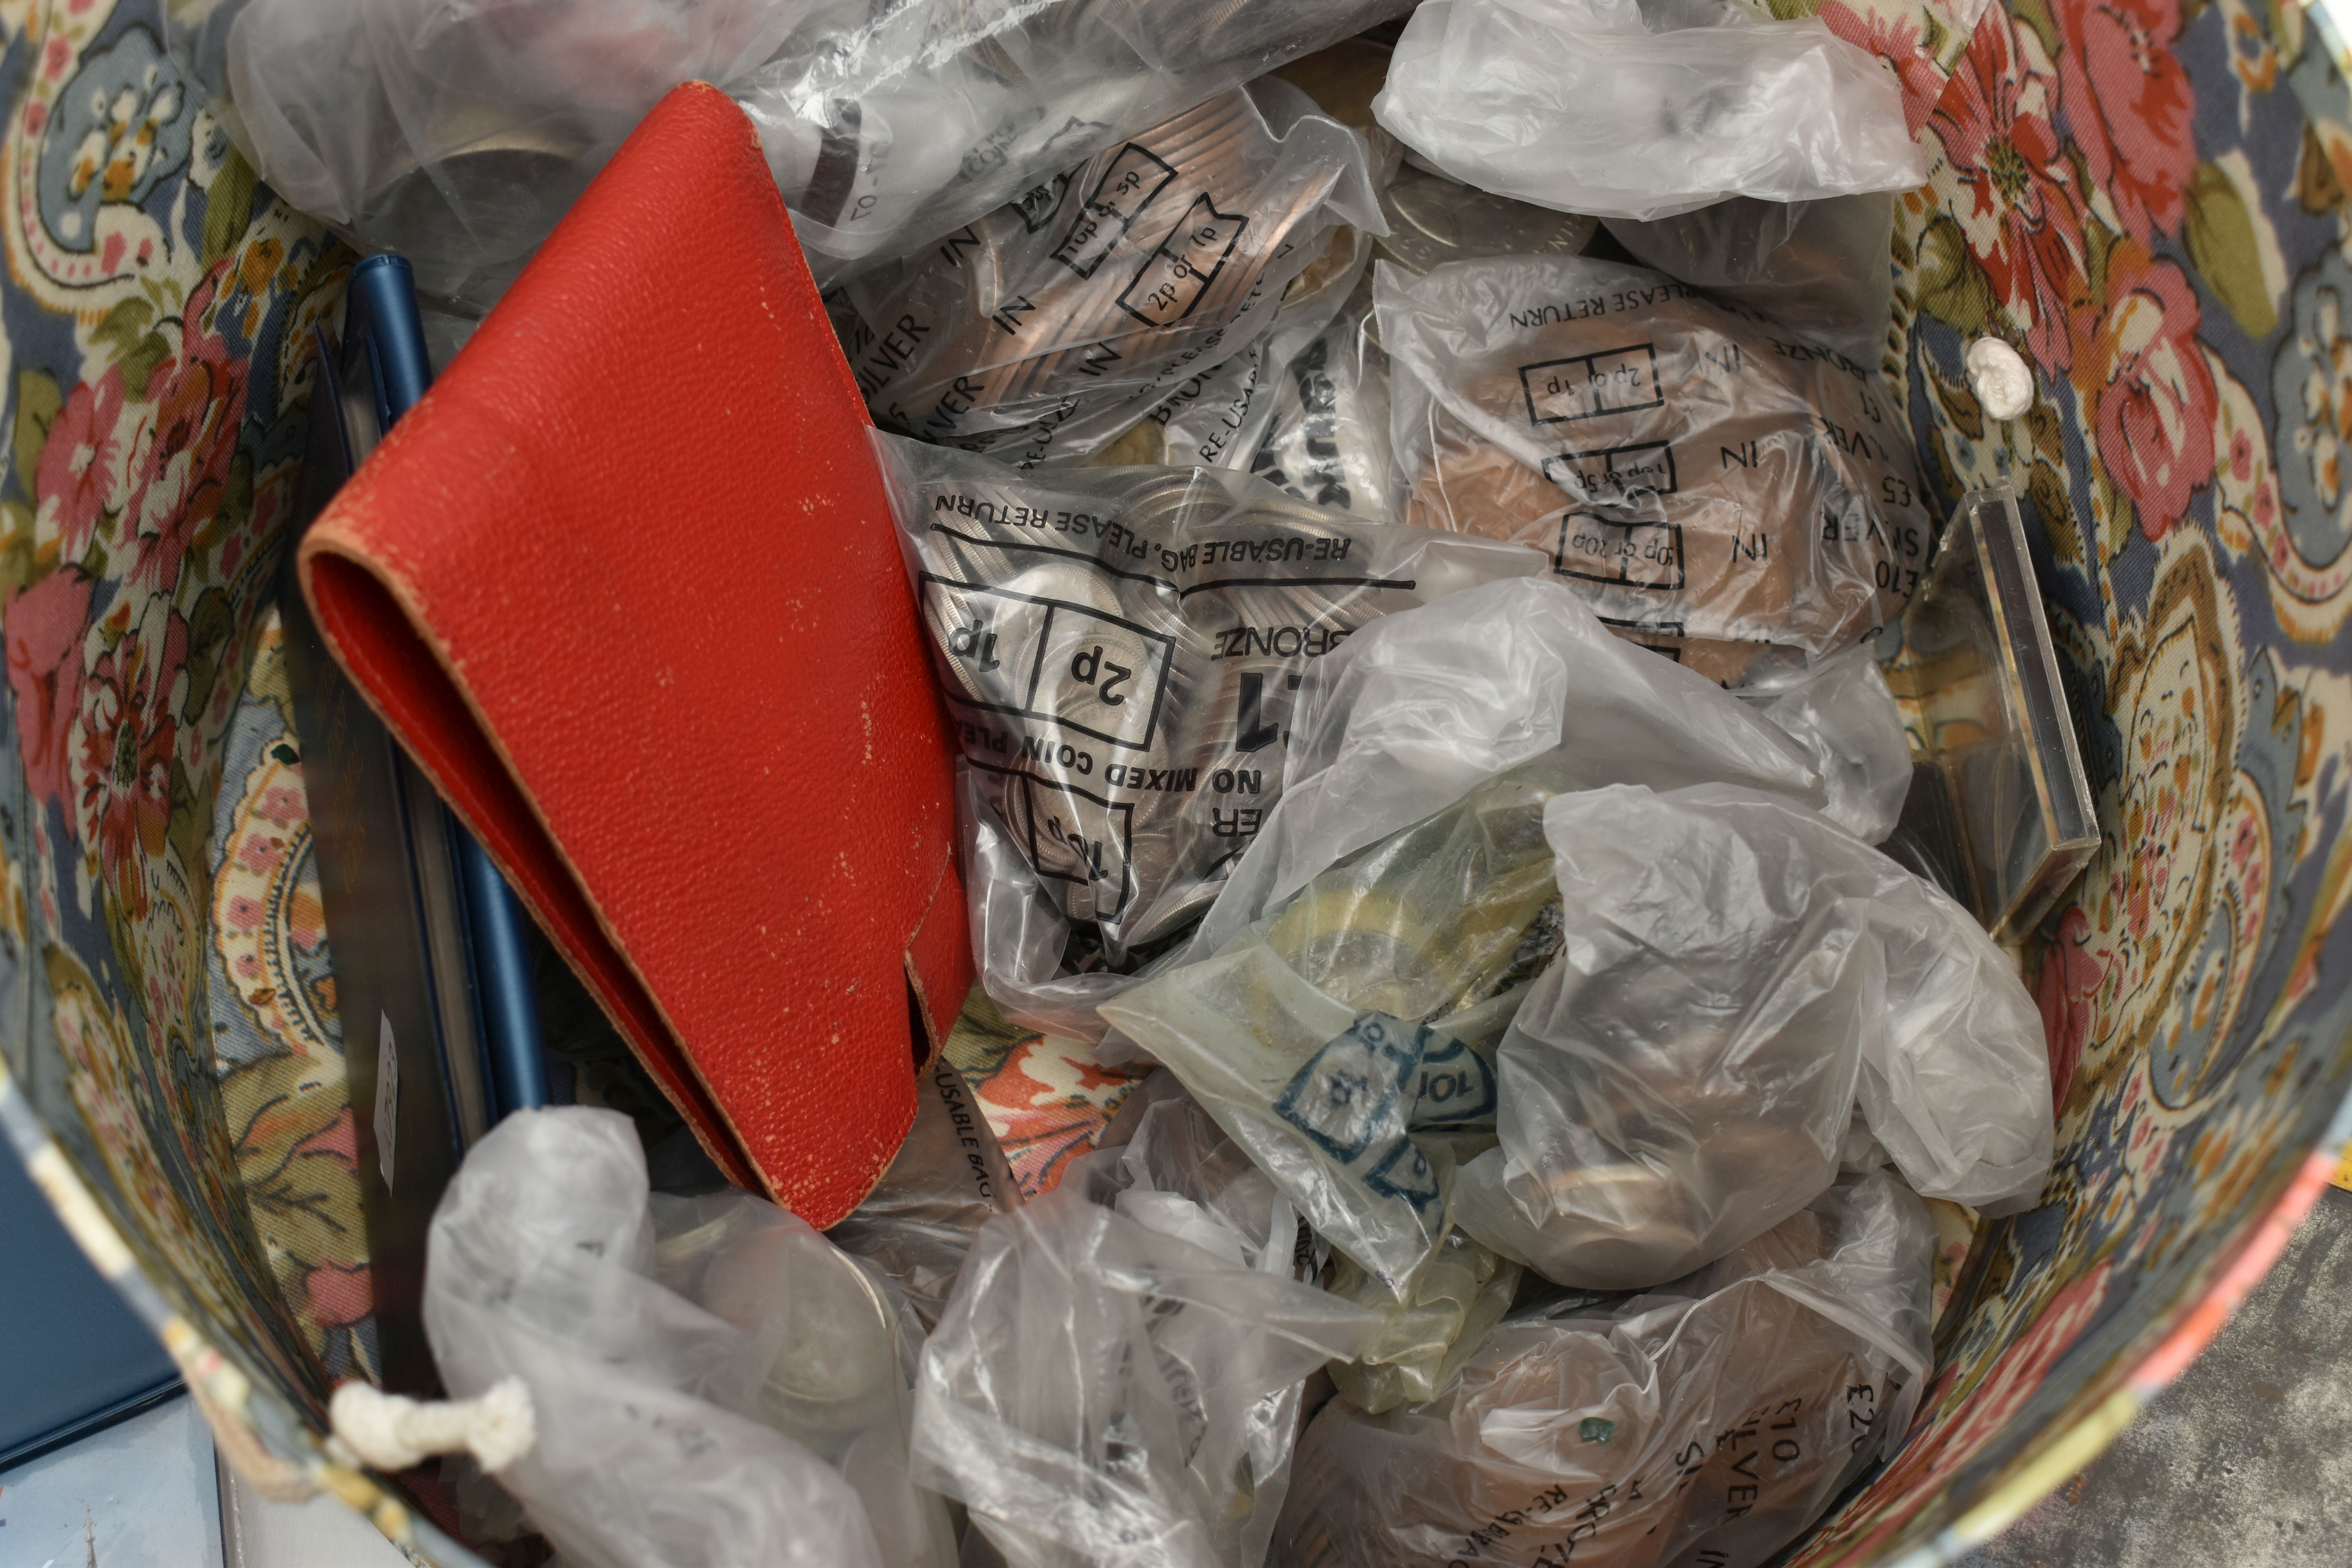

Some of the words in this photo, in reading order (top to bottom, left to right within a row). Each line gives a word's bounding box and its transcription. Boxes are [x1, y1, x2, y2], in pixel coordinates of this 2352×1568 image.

[941, 225, 980, 267] IN
[992, 295, 1036, 335] IN
[1078, 341, 1122, 377] IN
[1148, 282, 1178, 311] 2p
[1173, 254, 1193, 279] or
[1189, 226, 1218, 247] 1p
[1510, 297, 1607, 331] RETURN
[1614, 363, 1642, 387] 2p
[1720, 441, 1759, 469] IN
[1882, 476, 1911, 508] £5
[935, 495, 1048, 529] RETURN
[1056, 511, 1147, 559] PLEASE
[1204, 537, 1352, 564] RE-USABLE
[1732, 533, 1768, 563] IN
[1875, 560, 1919, 599] £10
[948, 620, 1001, 673] 1p
[1071, 646, 1132, 706] 2p
[1022, 735, 1093, 775] COIN
[1104, 762, 1198, 791] MIXED
[1212, 768, 1261, 794] NO
